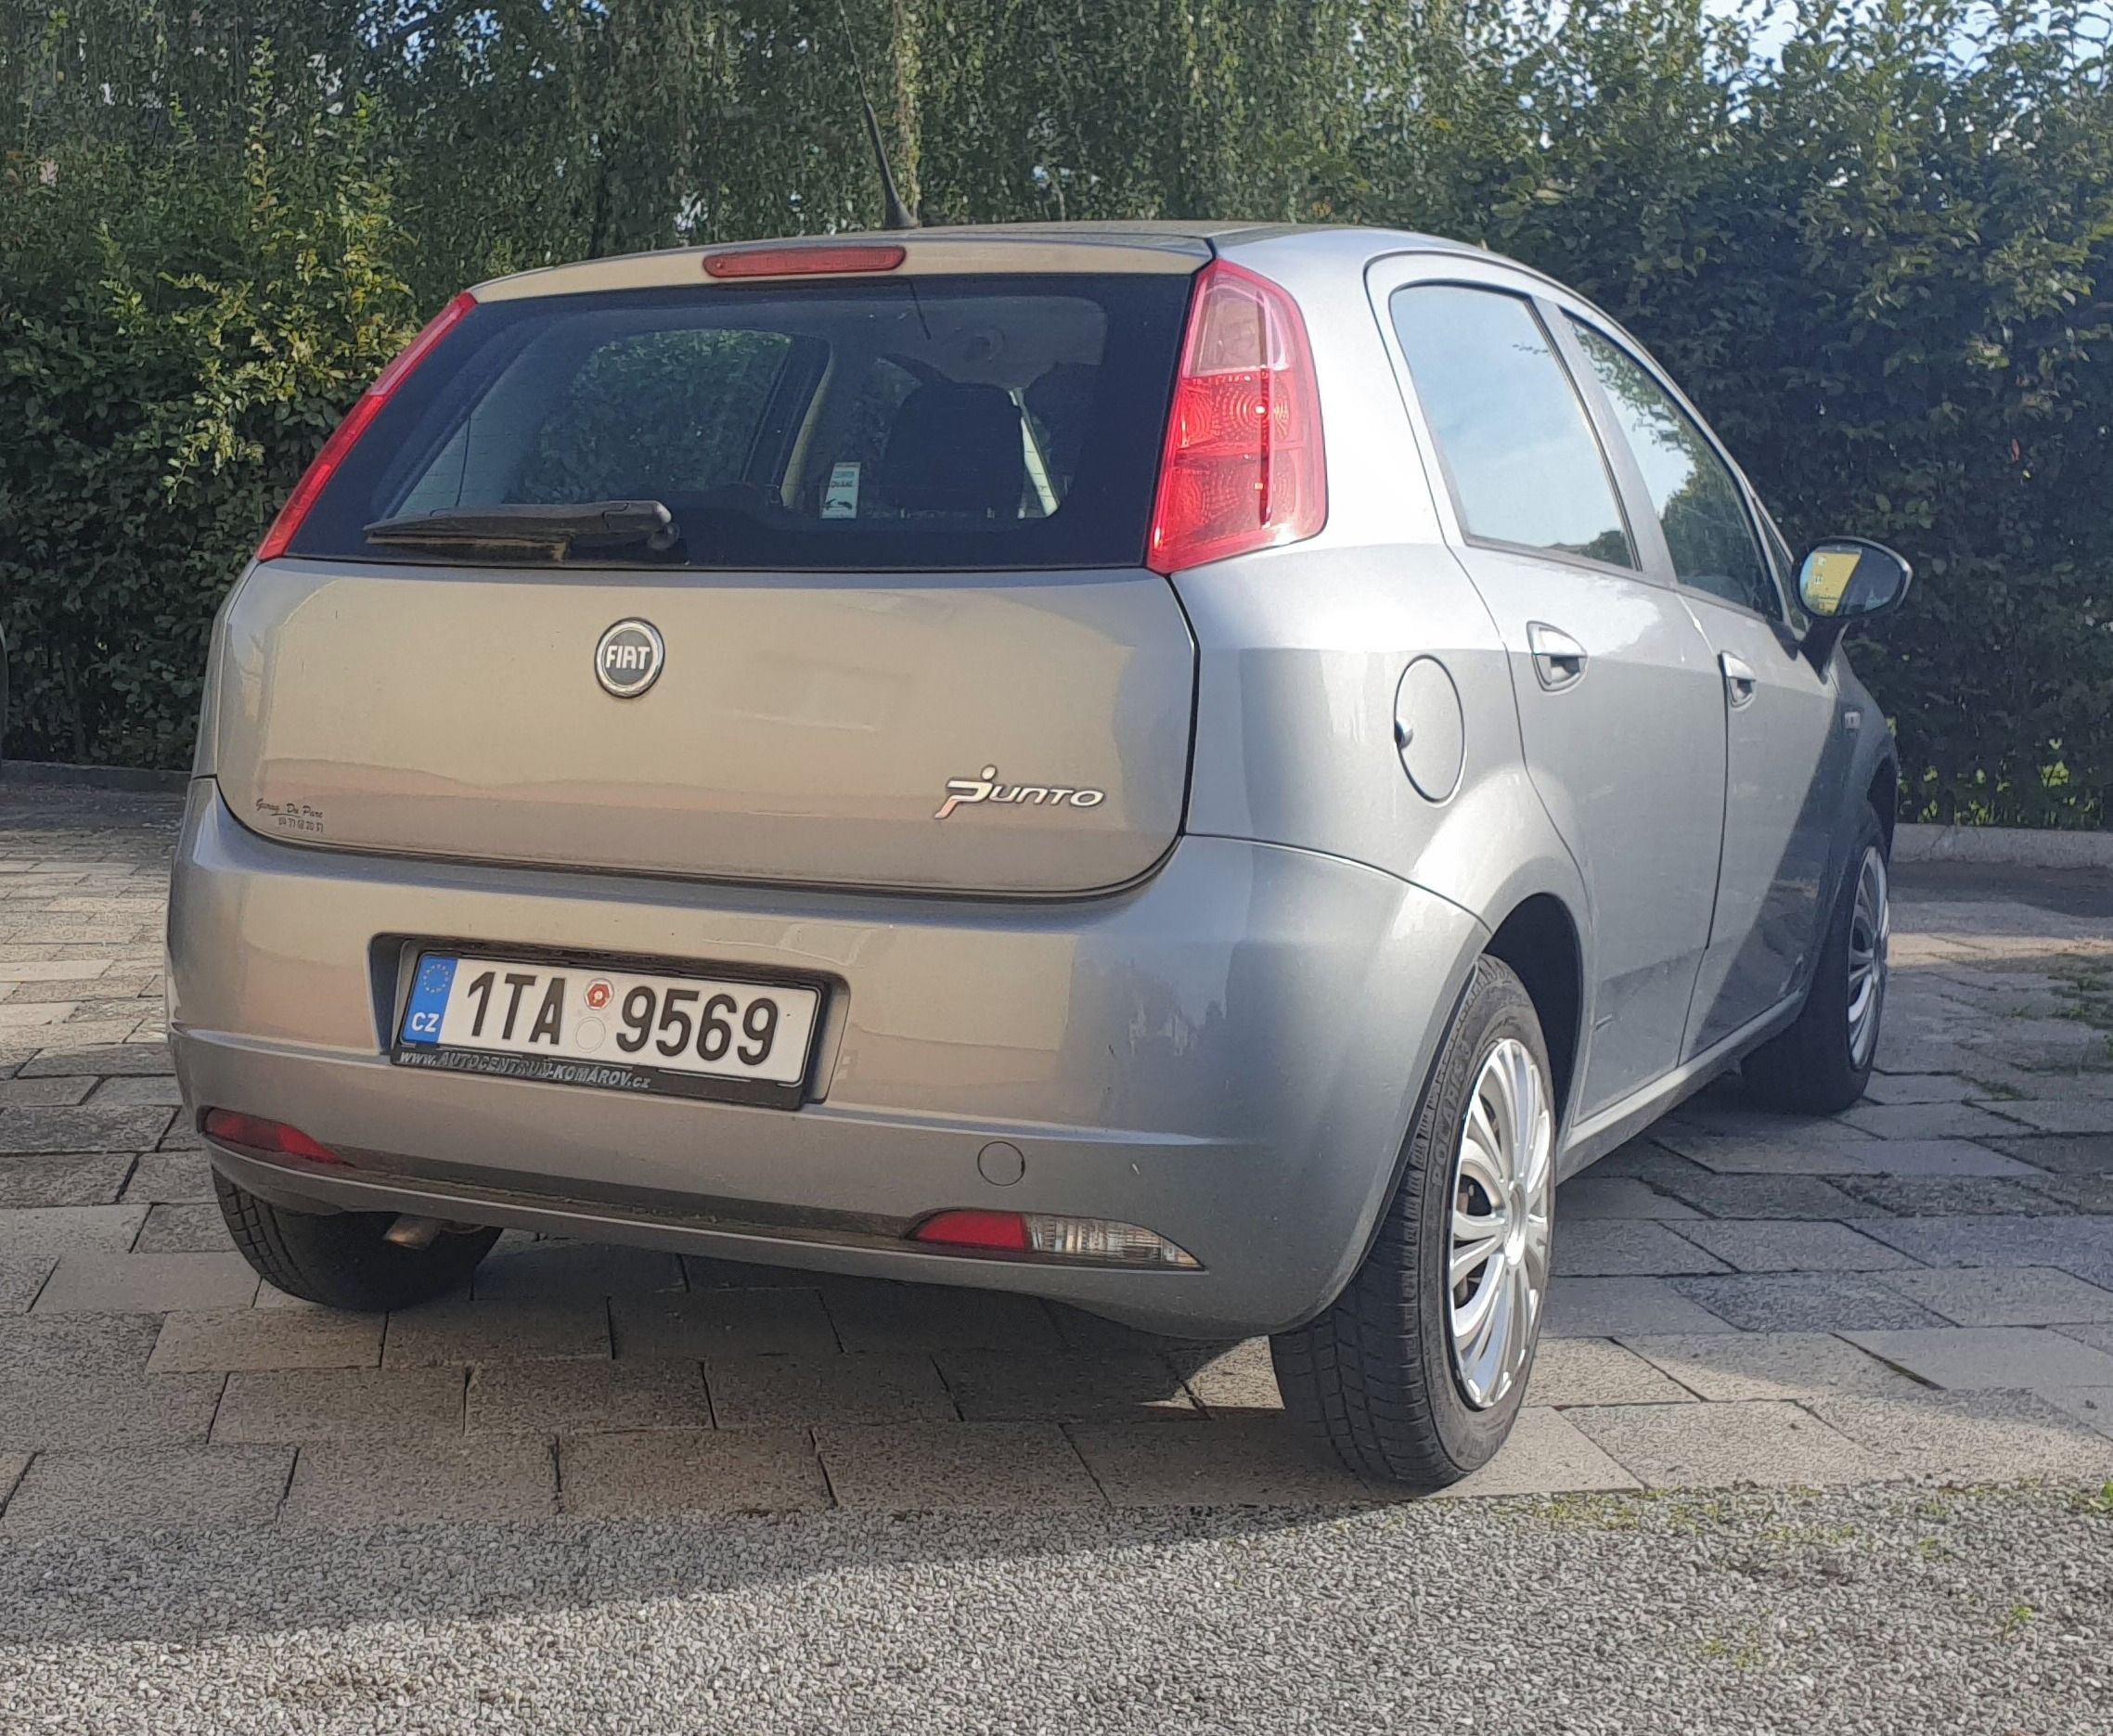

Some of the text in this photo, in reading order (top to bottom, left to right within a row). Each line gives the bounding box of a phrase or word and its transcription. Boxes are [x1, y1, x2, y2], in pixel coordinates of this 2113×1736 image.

[605, 645, 651, 670] FIAT
[411, 1010, 438, 1034] CZ
[468, 971, 779, 1066] 1TA 9569
